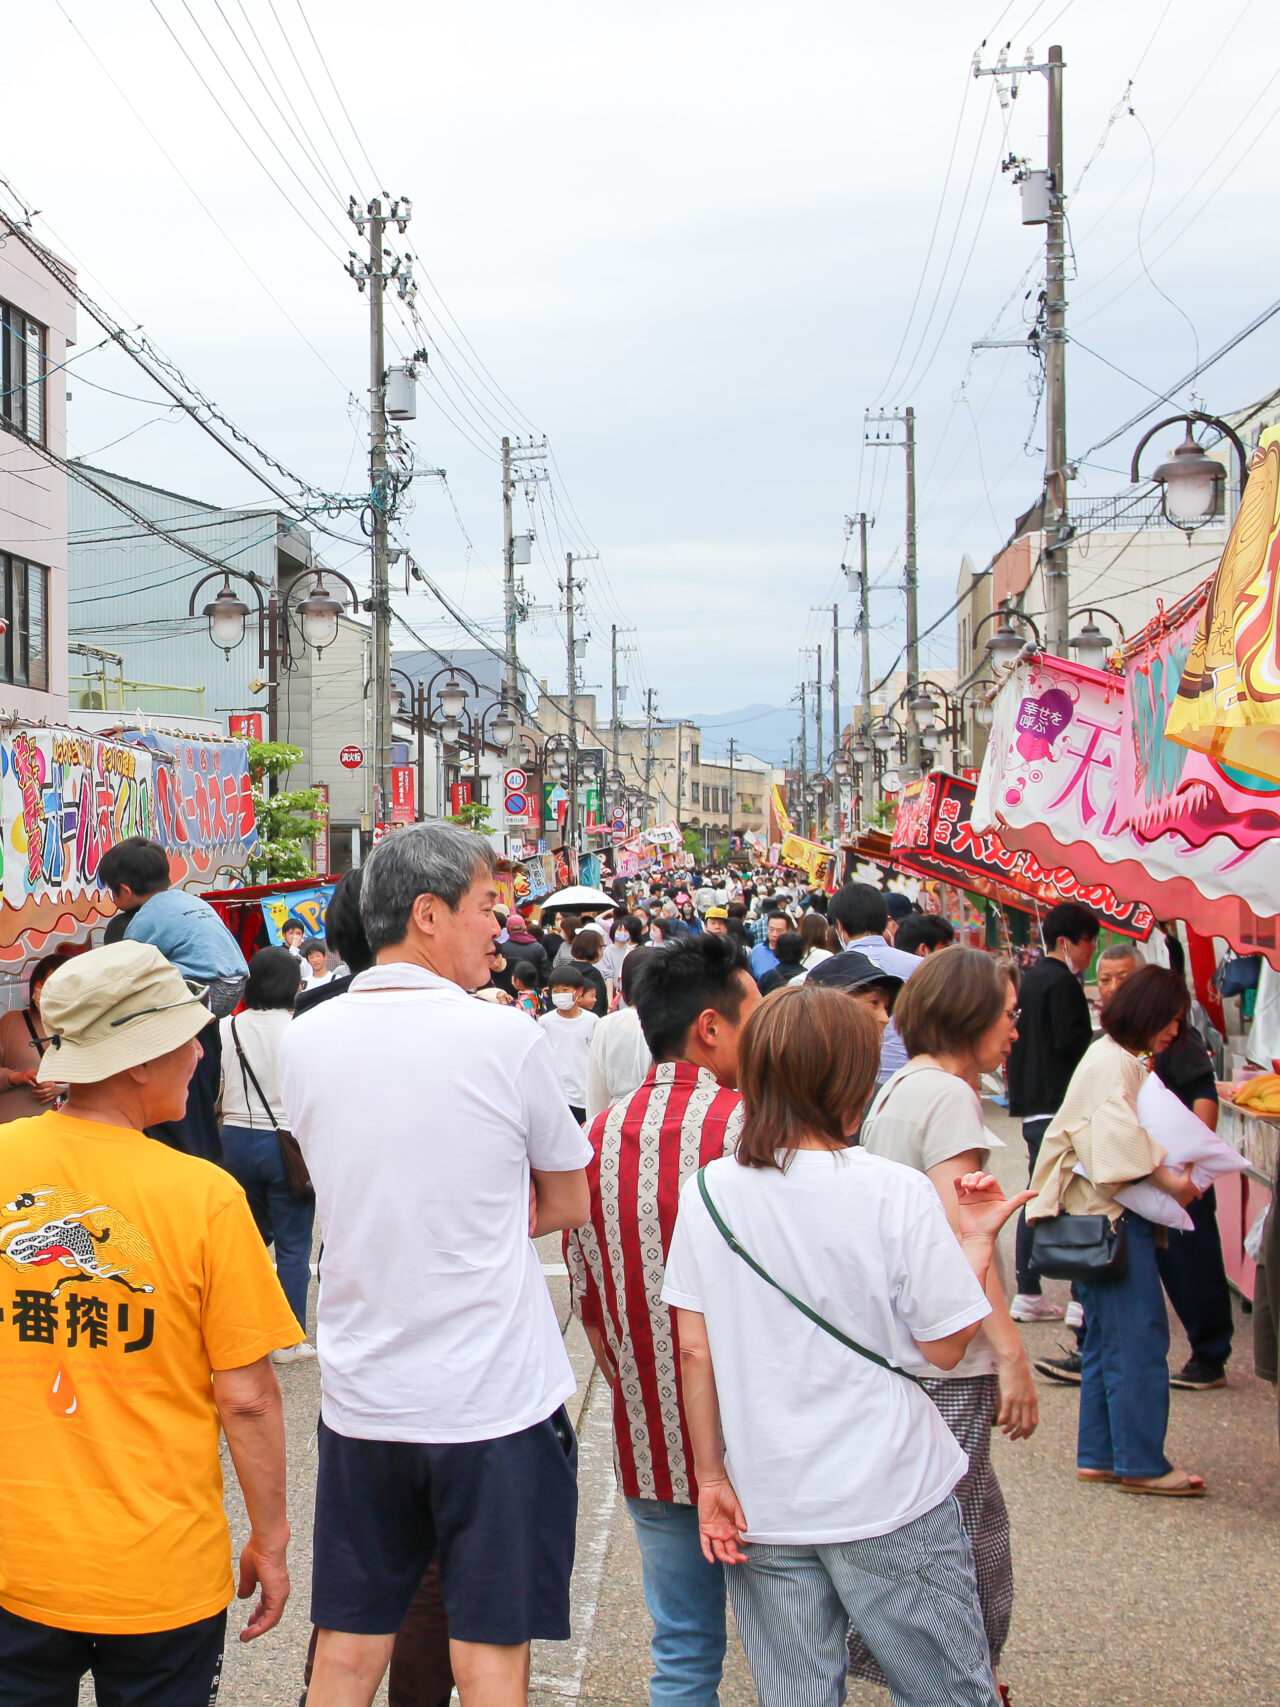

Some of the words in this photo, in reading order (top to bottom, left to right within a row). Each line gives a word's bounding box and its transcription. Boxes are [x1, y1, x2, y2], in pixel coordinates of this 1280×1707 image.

[1024, 701, 1062, 728] 幸せを
[1020, 715, 1047, 735] 呼ぶ
[342, 752, 361, 762] 消火栓
[509, 774, 522, 786] 40
[933, 798, 962, 845] 絶品
